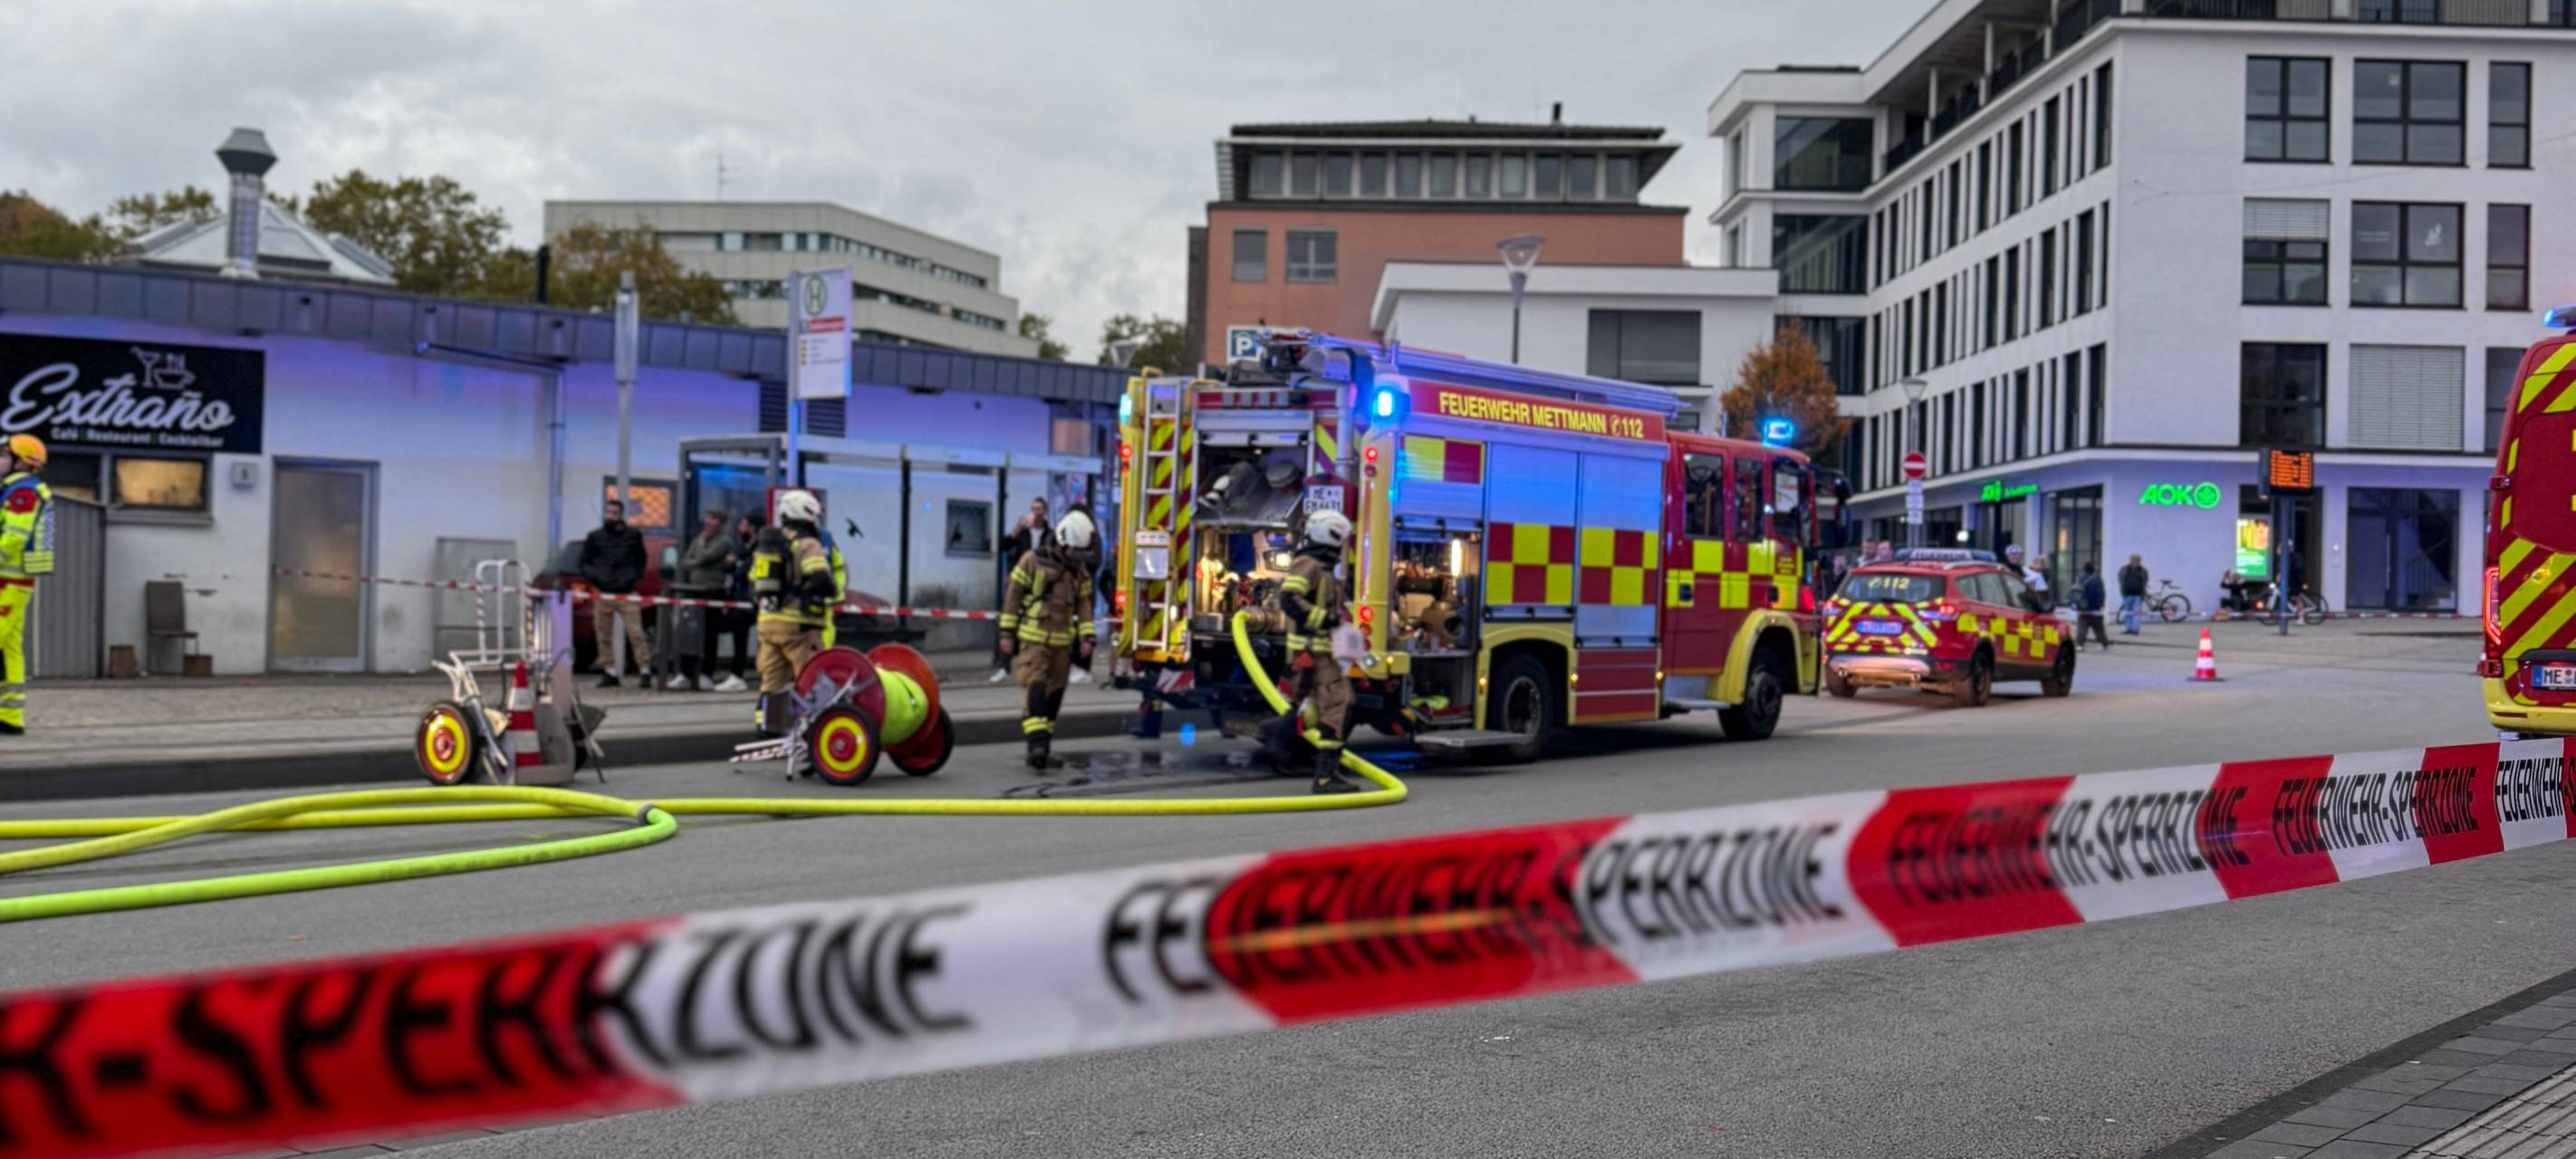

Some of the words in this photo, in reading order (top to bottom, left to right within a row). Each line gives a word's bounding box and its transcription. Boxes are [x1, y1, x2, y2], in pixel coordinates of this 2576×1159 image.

[1236, 337, 1253, 356] P
[0, 363, 235, 432] Extraño
[1439, 391, 1531, 424] FEUERWEHR
[1533, 405, 1607, 434] METTMANN
[1622, 417, 1644, 438] 112
[87, 430, 151, 445] Restaurant
[159, 433, 224, 447] Cocktailbar
[2139, 484, 2193, 507] AOK
[1883, 577, 1909, 589] 112
[2543, 669, 2563, 685] ME
[2272, 766, 2478, 857] FEUERWEHR-SPERRZONE
[1889, 785, 2251, 906] FEUERWEHR-SPERRZONE
[1102, 823, 1847, 1007] FEUERWEHR-SPERRZONE
